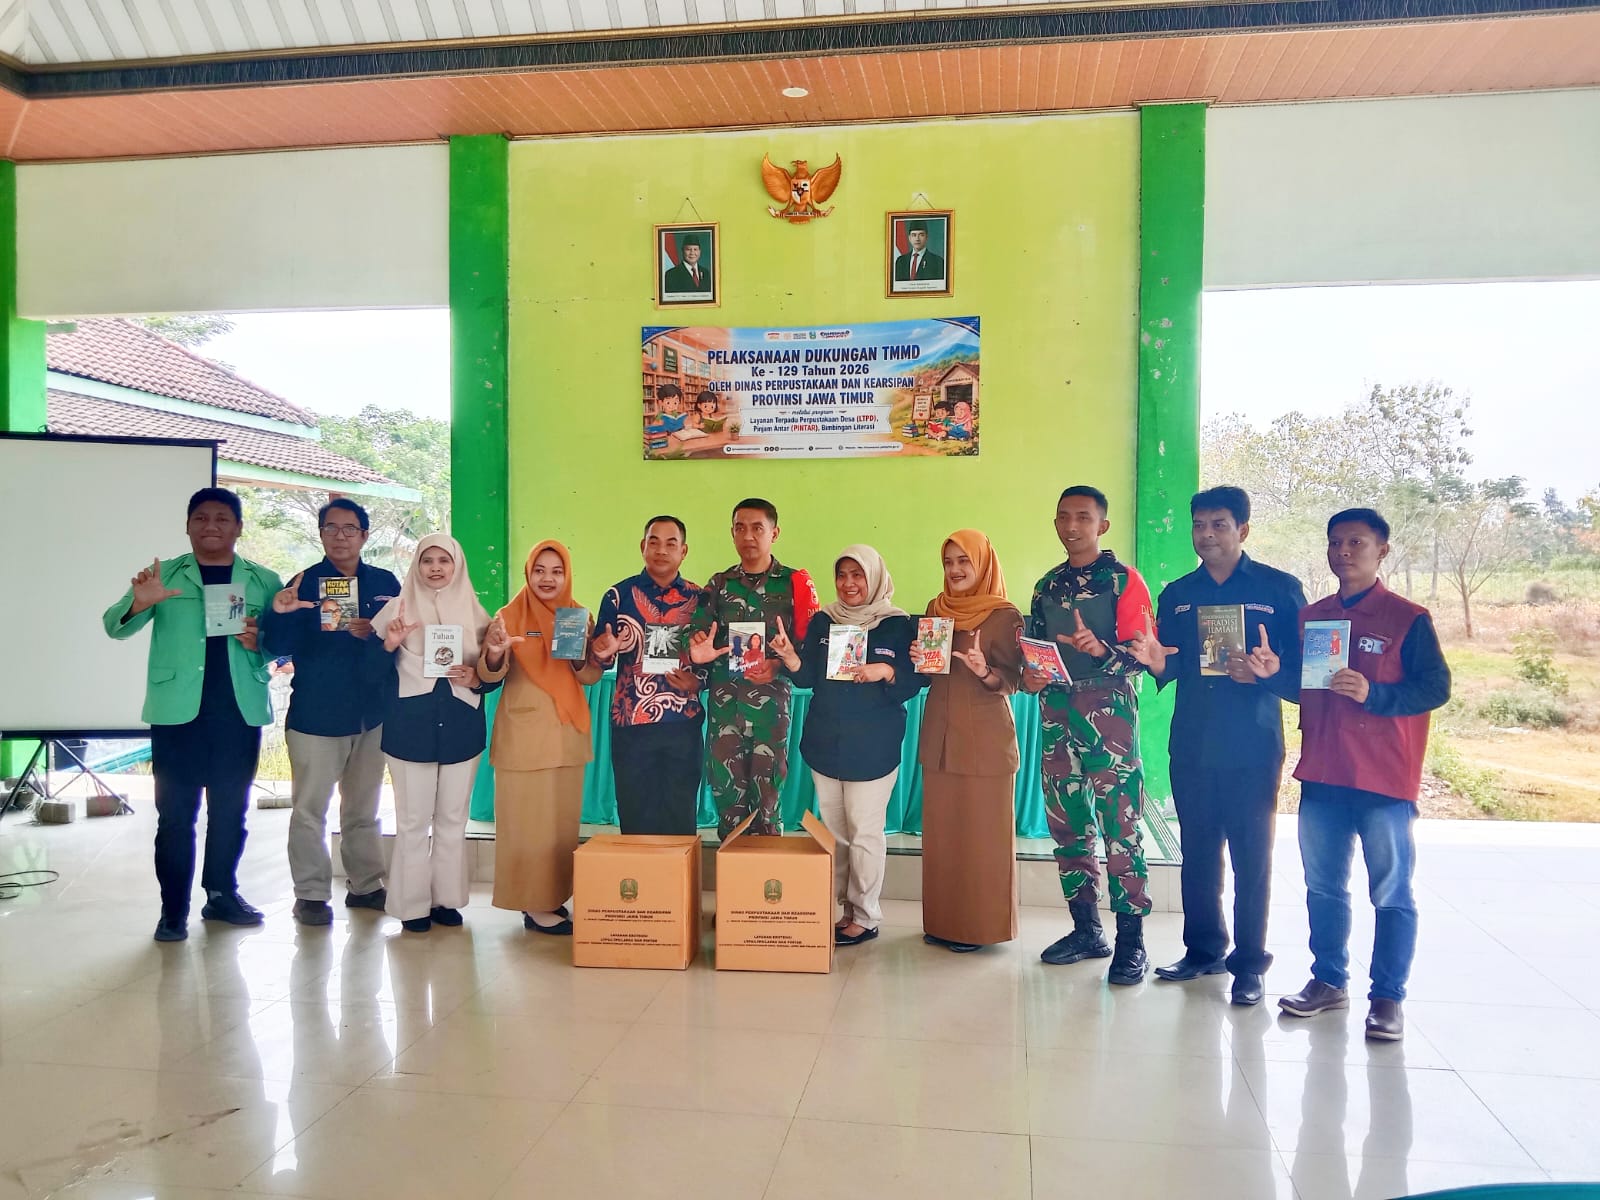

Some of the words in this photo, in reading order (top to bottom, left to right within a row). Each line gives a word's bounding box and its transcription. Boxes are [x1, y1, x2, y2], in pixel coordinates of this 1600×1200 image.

[708, 349, 800, 364] PELAKSANAAN
[804, 346, 878, 362] DUKUNGAN
[882, 344, 920, 360] TMMD
[752, 366, 765, 376] Ke
[778, 366, 798, 376] 129
[802, 365, 836, 376] Tahun
[840, 364, 870, 375] 2026
[709, 381, 732, 392] OLEH
[734, 380, 762, 391] DINAS
[766, 379, 838, 390] PERPUSTAKAAN
[842, 378, 860, 389] DAN
[864, 377, 914, 388] KEARSIPAN
[752, 394, 802, 406] PROVINSI
[806, 392, 836, 405] JAWA
[840, 392, 874, 404] TIMUR
